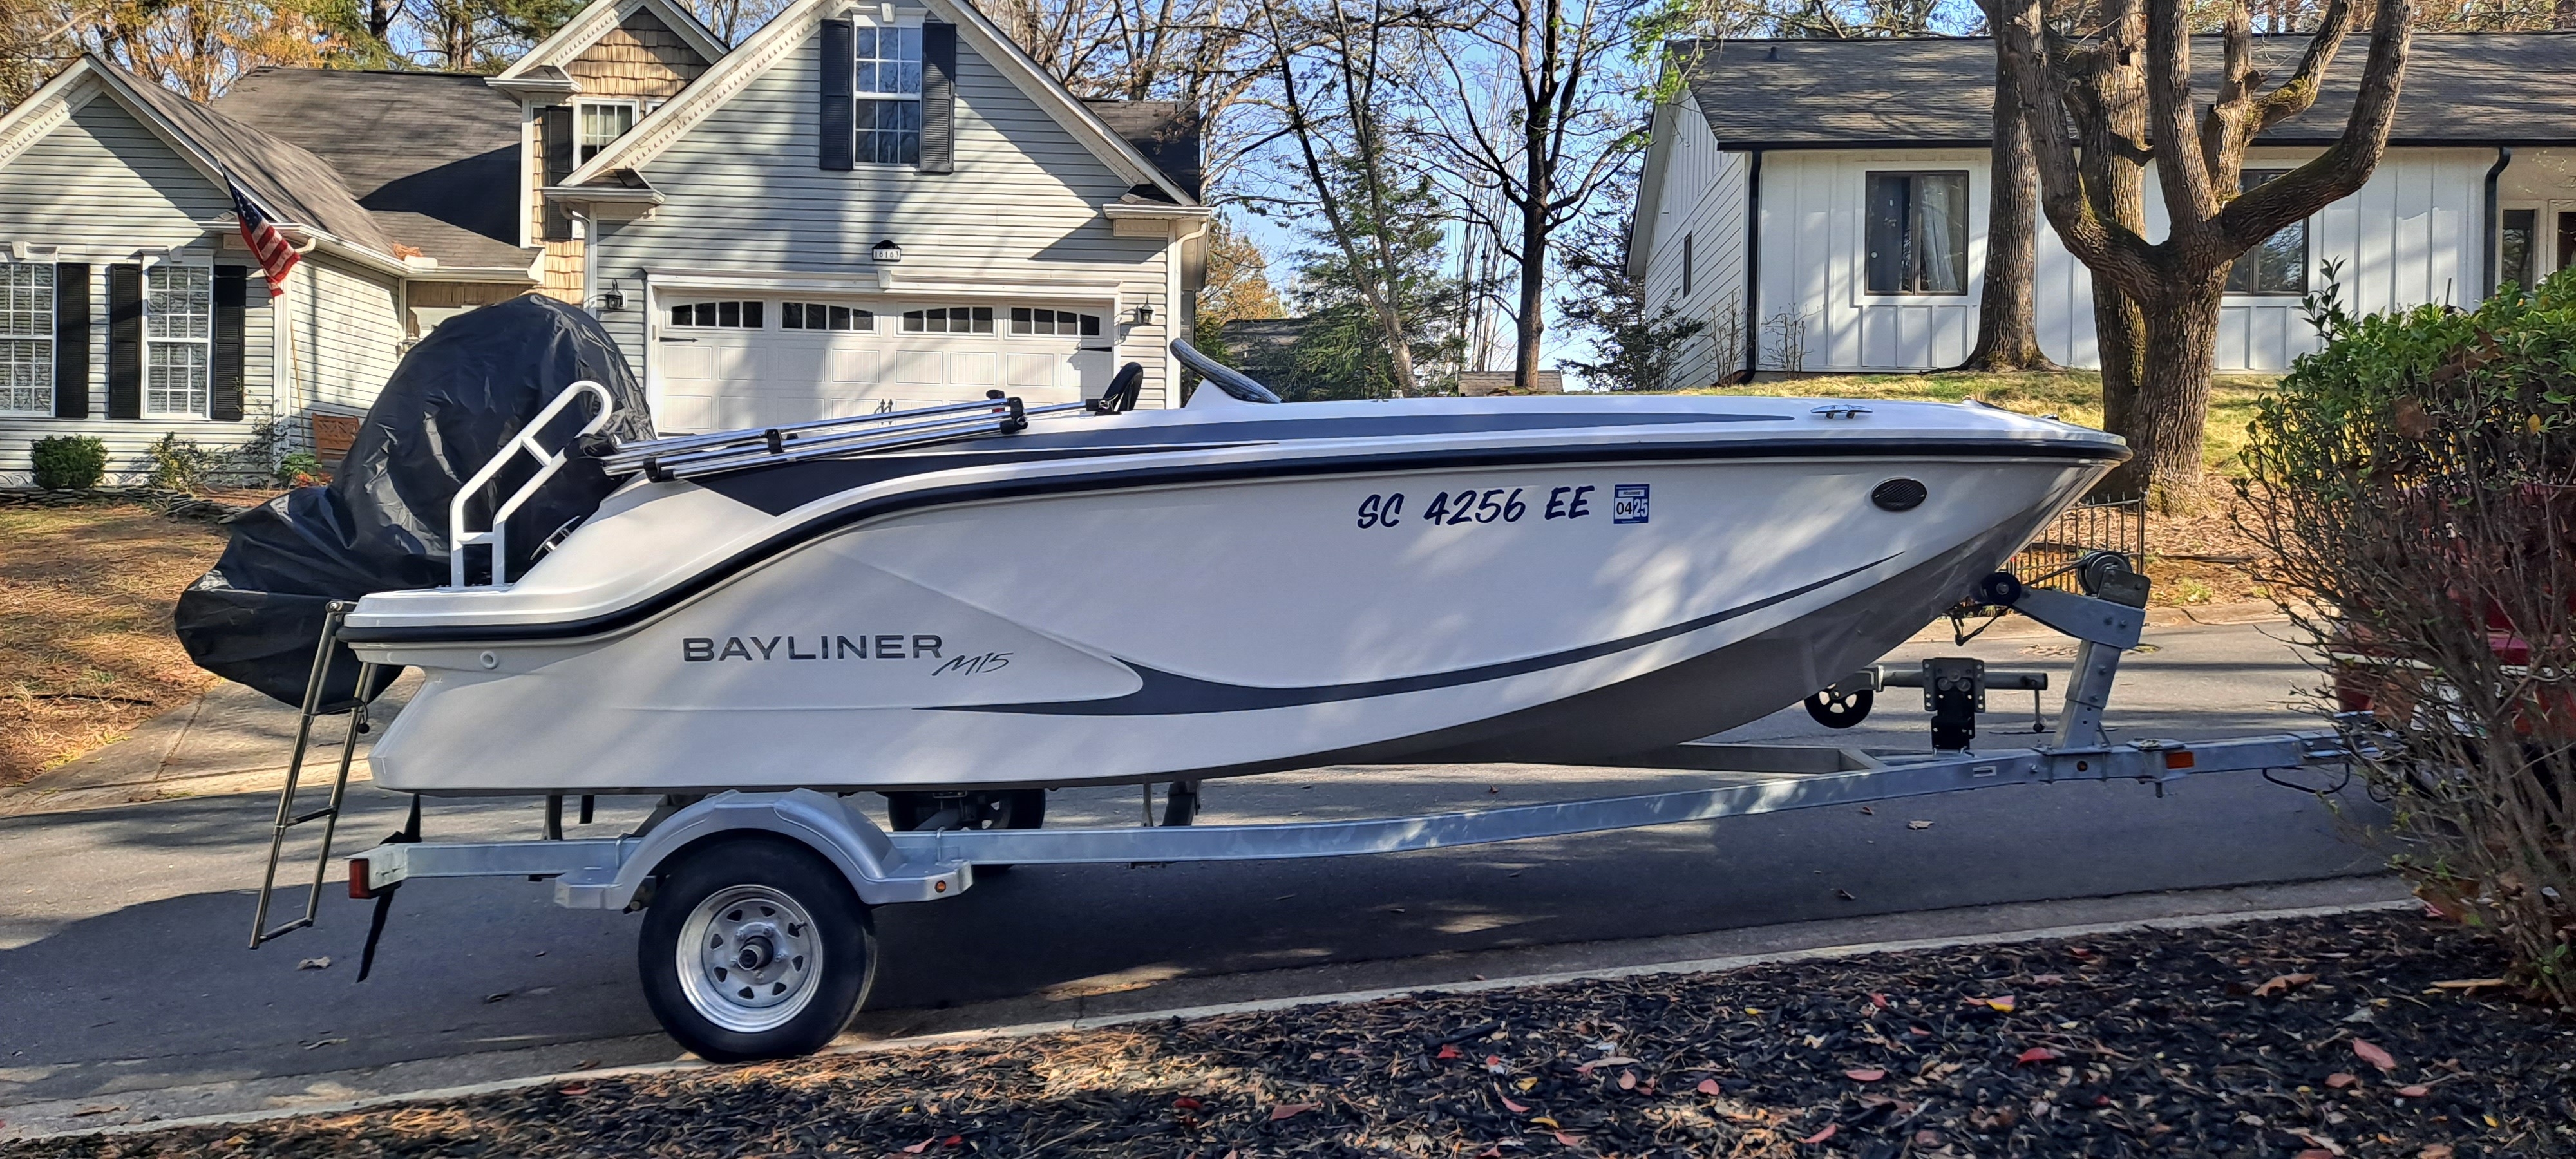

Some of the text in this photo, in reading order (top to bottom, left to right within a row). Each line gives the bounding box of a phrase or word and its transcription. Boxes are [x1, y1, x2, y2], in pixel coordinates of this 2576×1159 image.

[1357, 485, 1595, 529] SC 4256 EE
[1616, 498, 1648, 518] 04 25
[683, 634, 942, 661] BAYLINER
[931, 652, 1014, 676] M15
